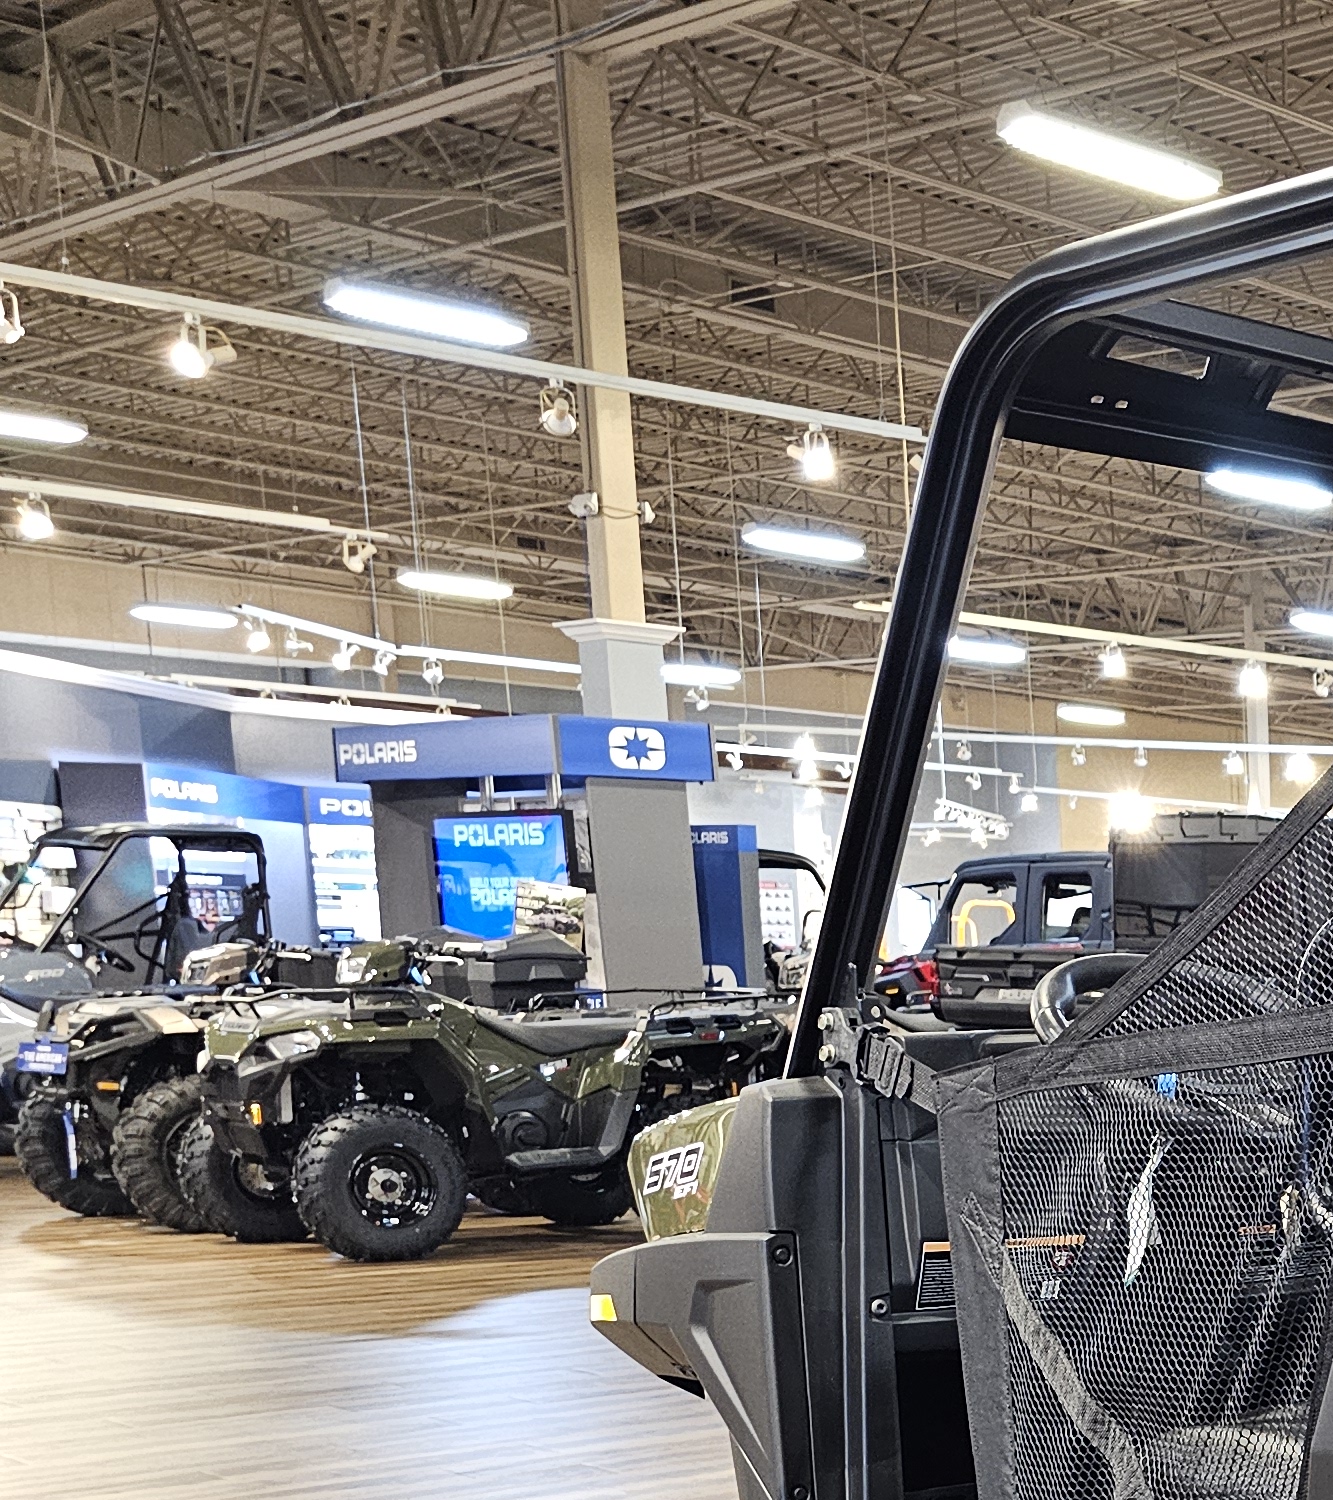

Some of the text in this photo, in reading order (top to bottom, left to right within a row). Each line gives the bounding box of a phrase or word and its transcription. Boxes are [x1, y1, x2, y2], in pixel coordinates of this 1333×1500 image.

[339, 740, 417, 765] POLARIS
[150, 777, 219, 803] POLARIS
[453, 822, 545, 847] POLARIS
[642, 1141, 705, 1196] 570
